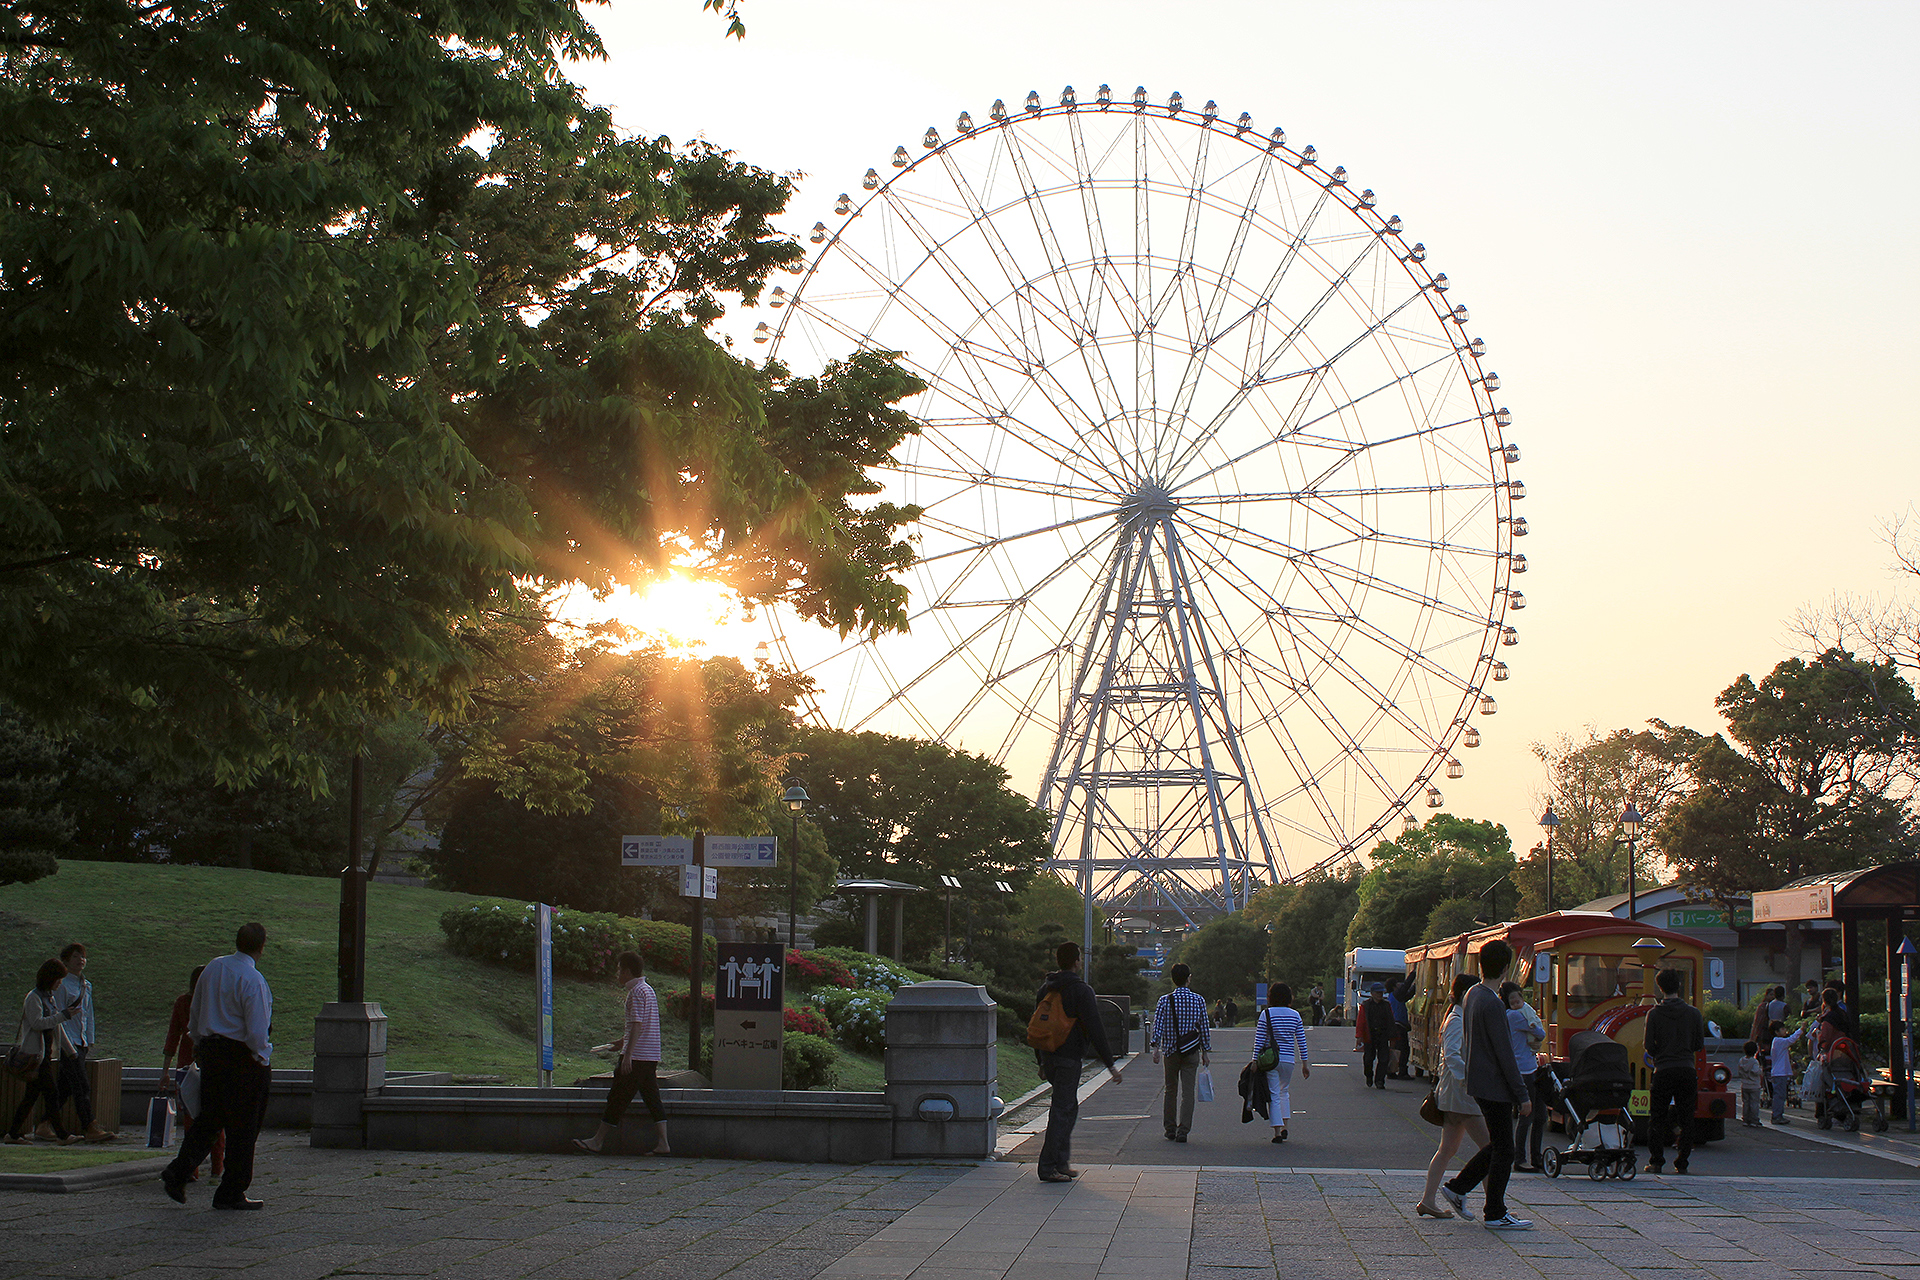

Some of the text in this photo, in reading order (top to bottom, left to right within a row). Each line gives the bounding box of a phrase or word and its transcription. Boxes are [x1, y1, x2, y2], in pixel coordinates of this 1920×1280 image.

[717, 1038, 778, 1050] バーベキュー広場
